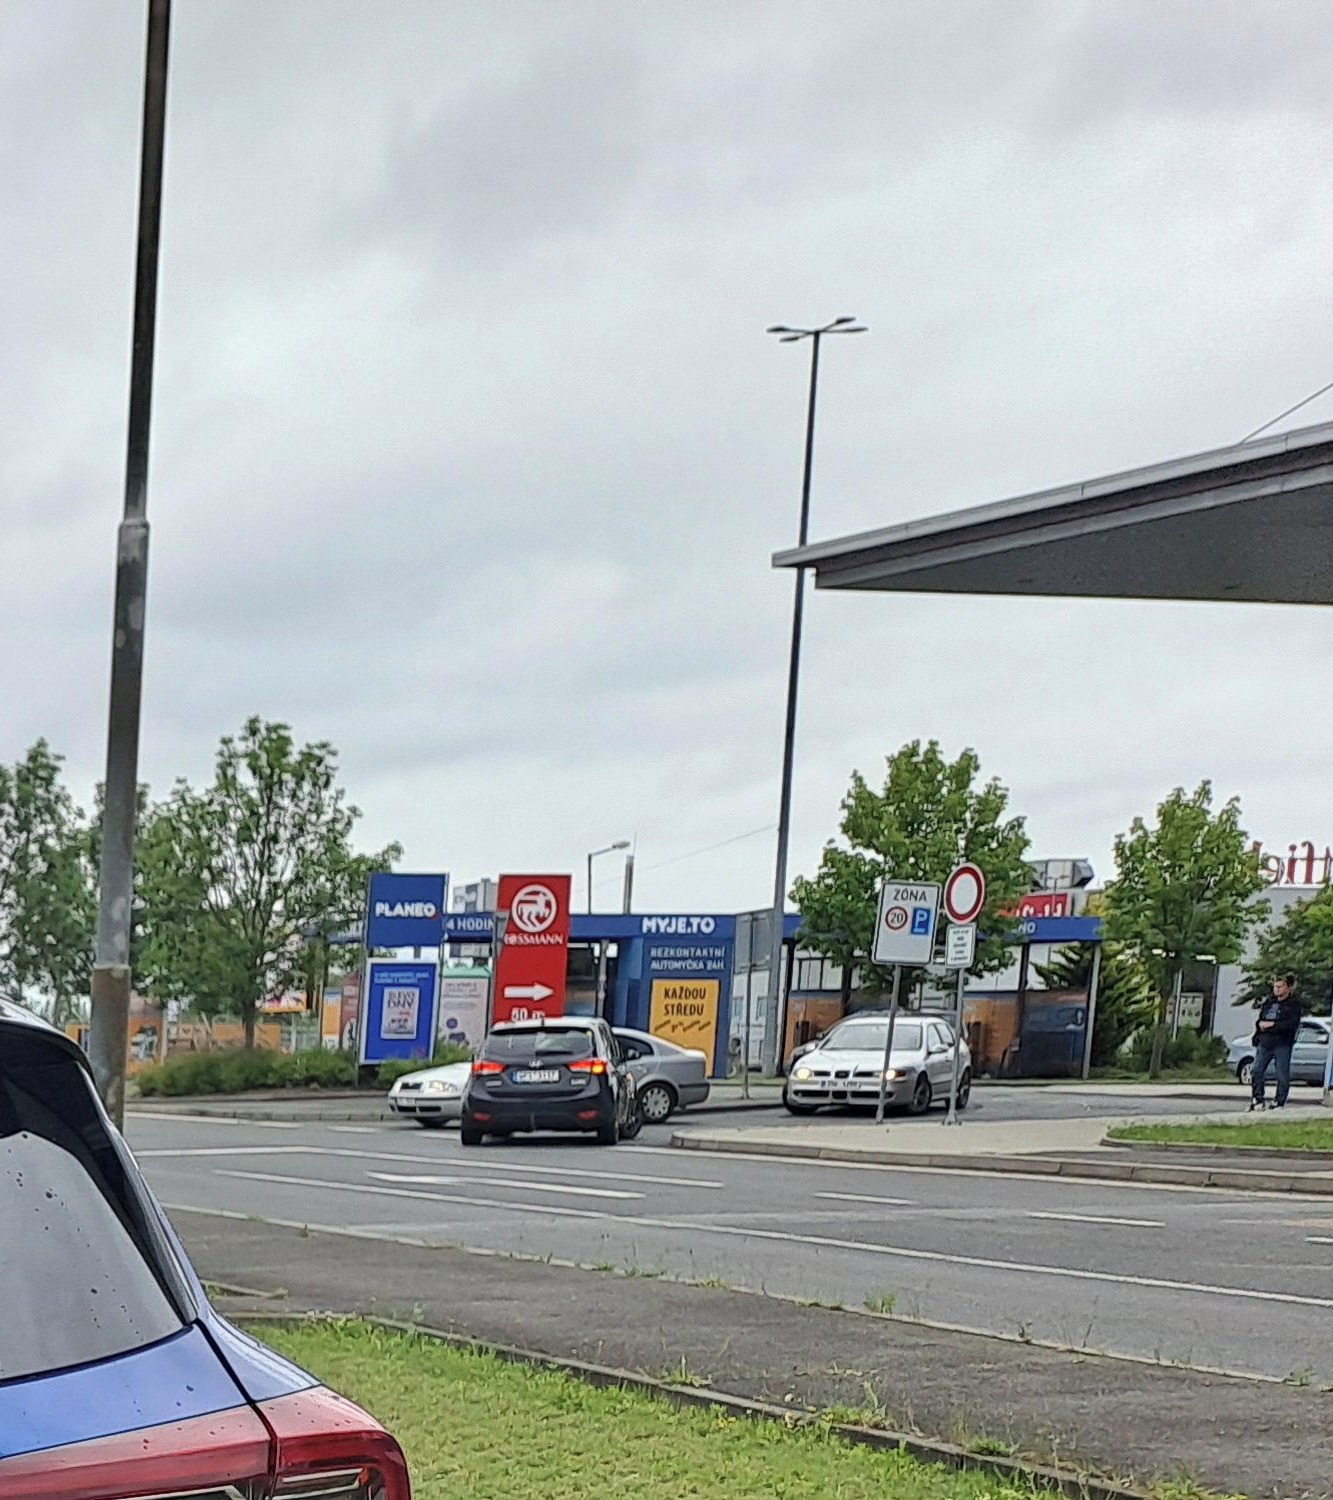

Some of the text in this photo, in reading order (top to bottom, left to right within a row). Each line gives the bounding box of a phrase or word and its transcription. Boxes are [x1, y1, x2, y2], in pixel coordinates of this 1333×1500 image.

[893, 888, 927, 902] ZÓNA
[374, 901, 436, 918] PLANEO
[891, 912, 904, 924] 20
[642, 917, 715, 934] MYJE.TO
[650, 946, 725, 958] BEZKONTAKTNÍ
[650, 959, 704, 970] AUTOMYČKA
[664, 985, 706, 999] KAŽDOU
[664, 1002, 704, 1016] STŘEDU
